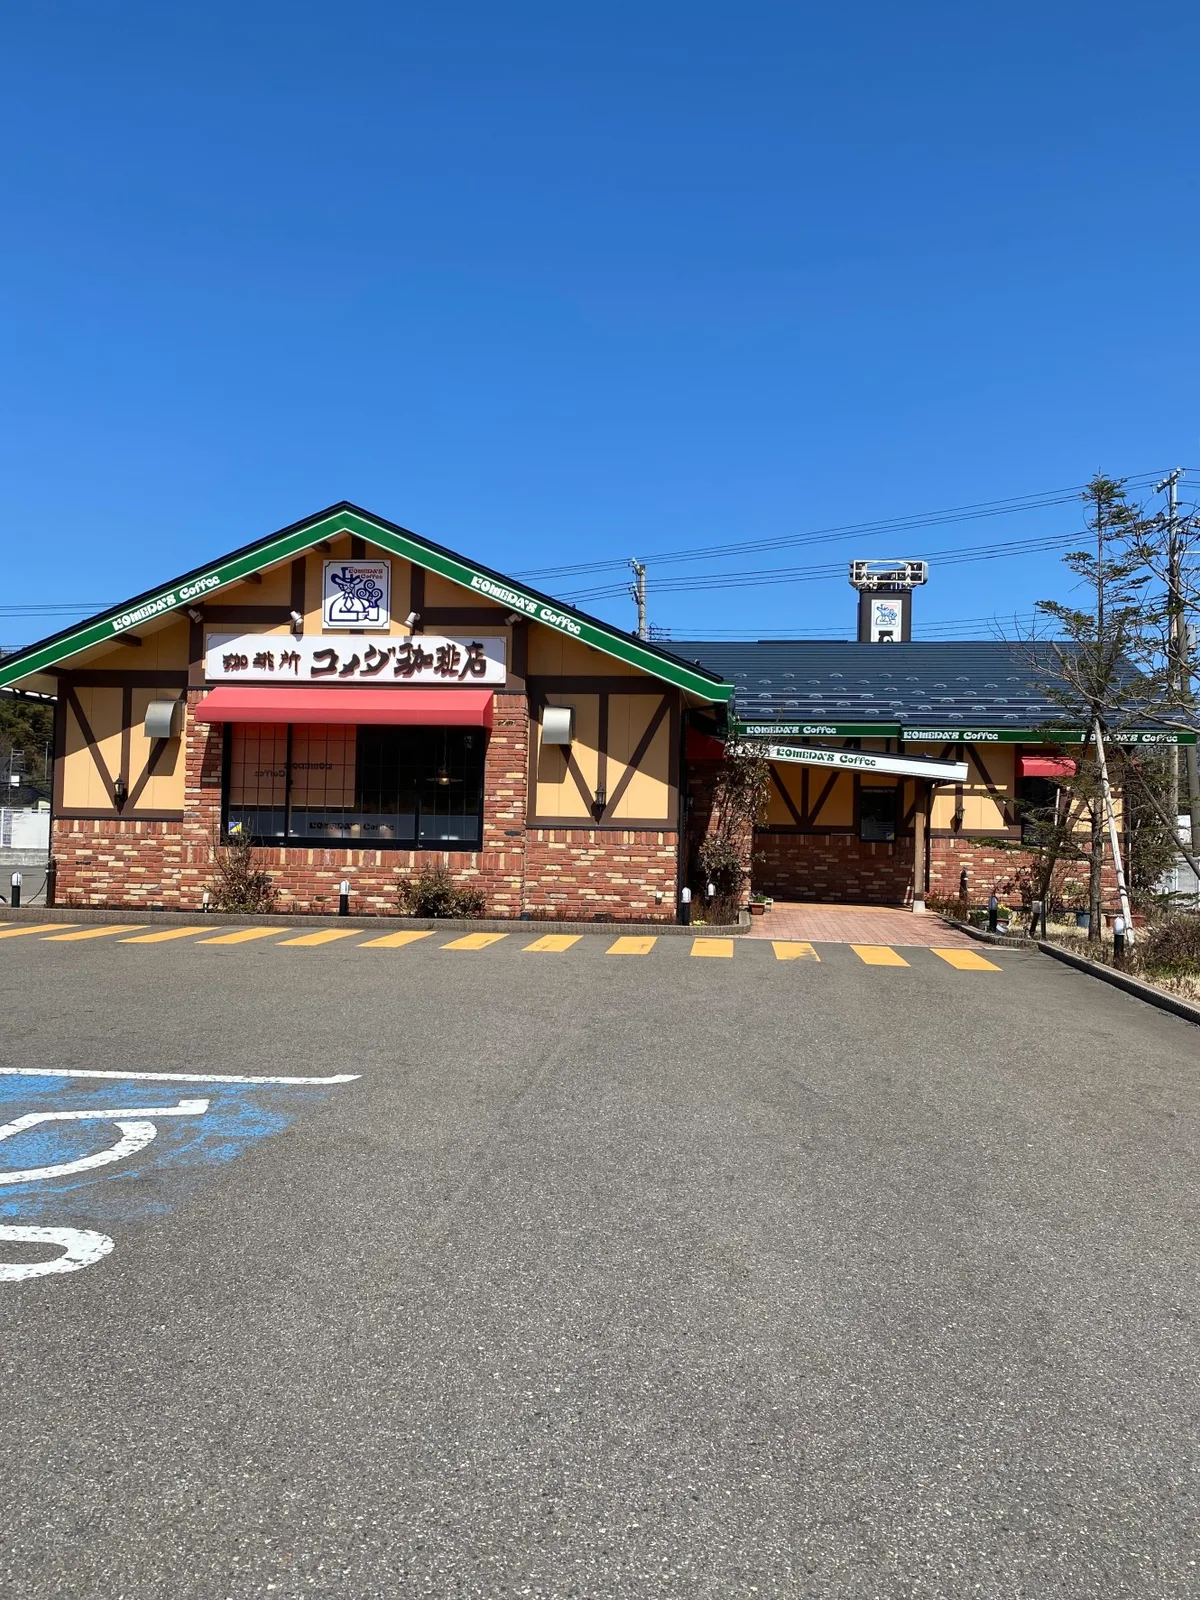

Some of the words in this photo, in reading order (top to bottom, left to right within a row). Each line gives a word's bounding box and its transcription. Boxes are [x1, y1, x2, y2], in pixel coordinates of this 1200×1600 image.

[111, 594, 176, 631] KOMEDA'S
[179, 576, 220, 599] Coffee
[470, 576, 537, 614] KOMEDA'S
[540, 608, 581, 635] Coffee
[310, 641, 487, 681] コメダ珈琲店
[746, 726, 799, 734] KOMEDA'S
[803, 726, 837, 734] Coffee
[903, 731, 959, 739] KOMEDA'S
[963, 732, 999, 740] Coffee
[1080, 734, 1138, 742] OEDA'S
[776, 748, 835, 762] KOMEDA'S
[839, 756, 876, 767] Coffee
[363, 823, 394, 831] Cofe
